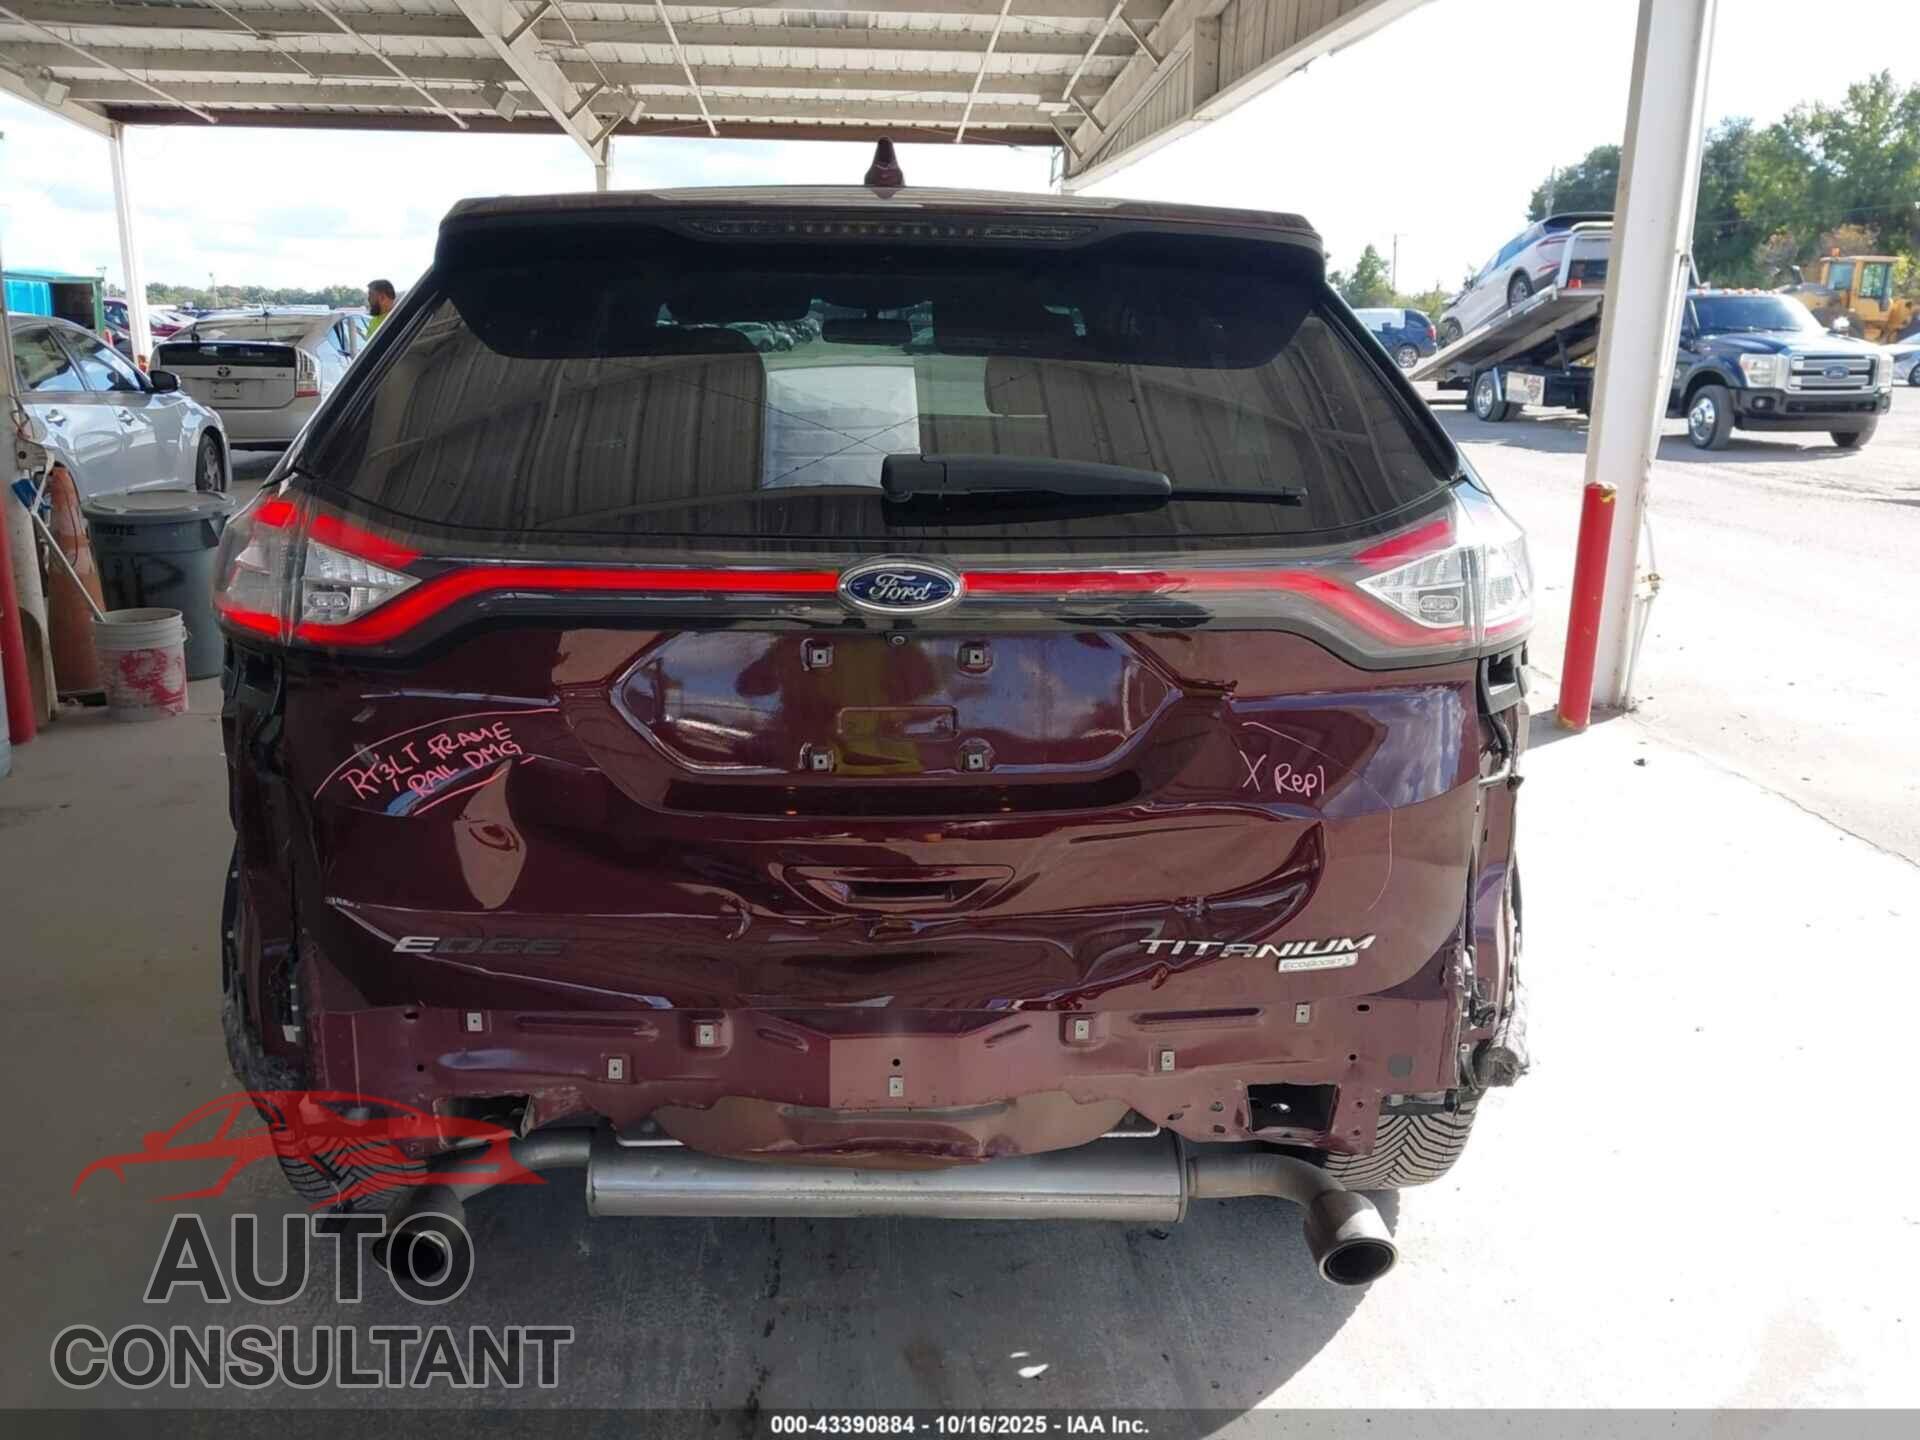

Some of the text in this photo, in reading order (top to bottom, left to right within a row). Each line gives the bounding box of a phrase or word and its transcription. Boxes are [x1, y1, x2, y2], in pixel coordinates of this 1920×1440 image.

[868, 572, 932, 601] Ford
[427, 721, 512, 760] FRAME
[407, 764, 460, 798] RAIL
[1239, 750, 1267, 793] X
[392, 936, 561, 954] EDGE
[1139, 934, 1377, 959] TITANIUM
